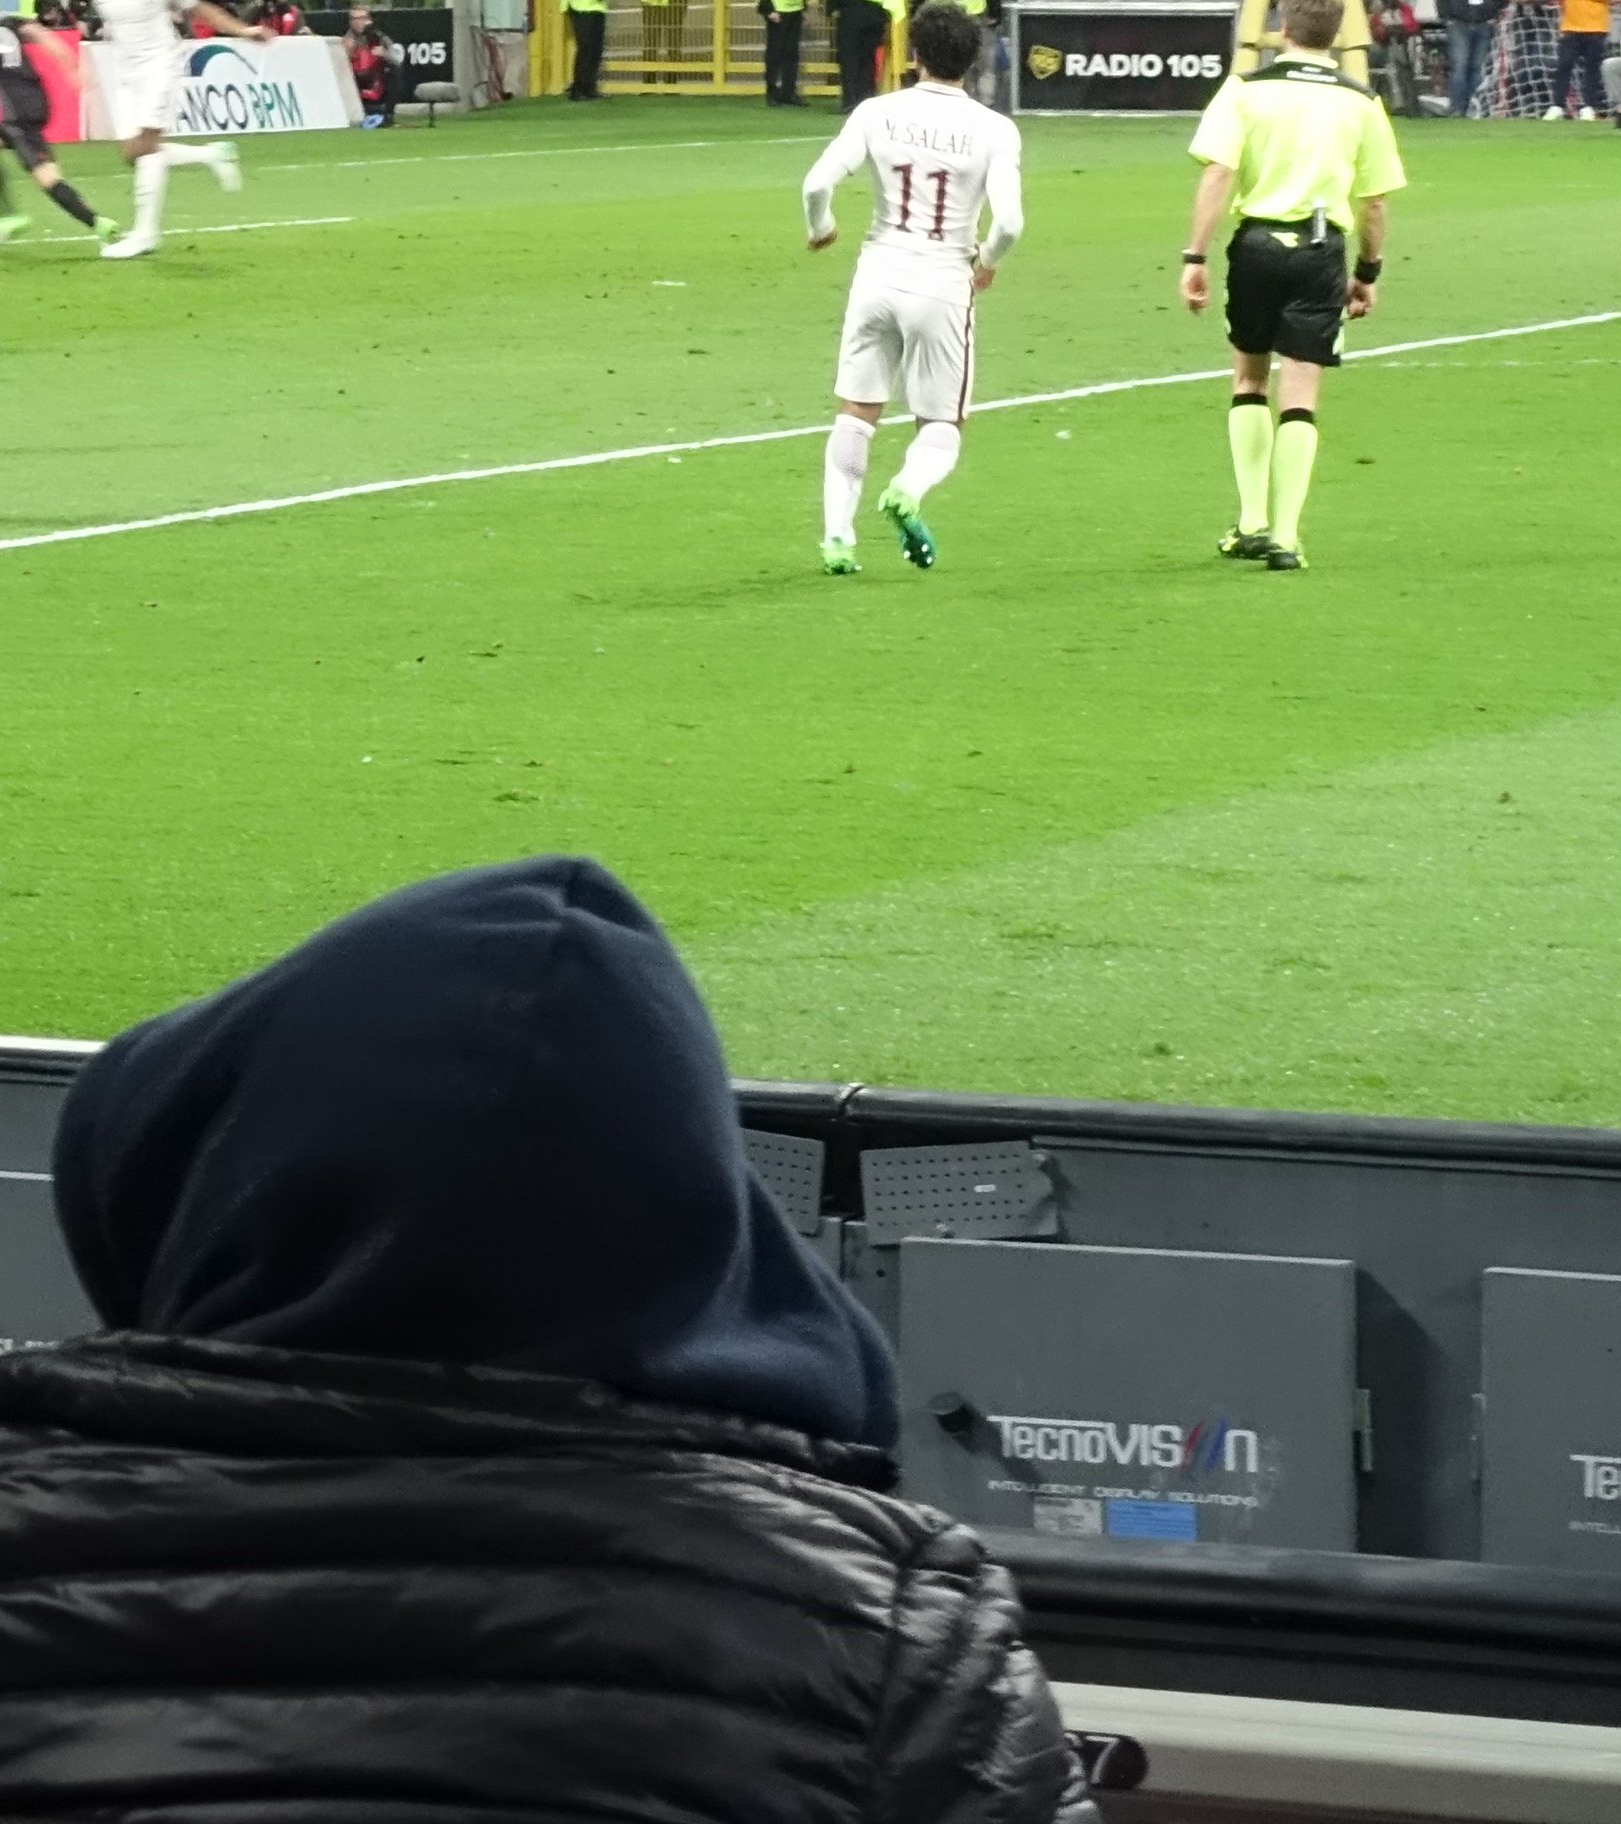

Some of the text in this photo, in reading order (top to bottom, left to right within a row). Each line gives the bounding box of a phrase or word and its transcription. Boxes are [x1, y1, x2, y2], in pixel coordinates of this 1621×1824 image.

[407, 41, 447, 65] 105
[1065, 53, 1223, 78] RADIO 105
[176, 82, 249, 132] ANCO
[902, 122, 974, 157] SALAH
[891, 162, 952, 243] 11
